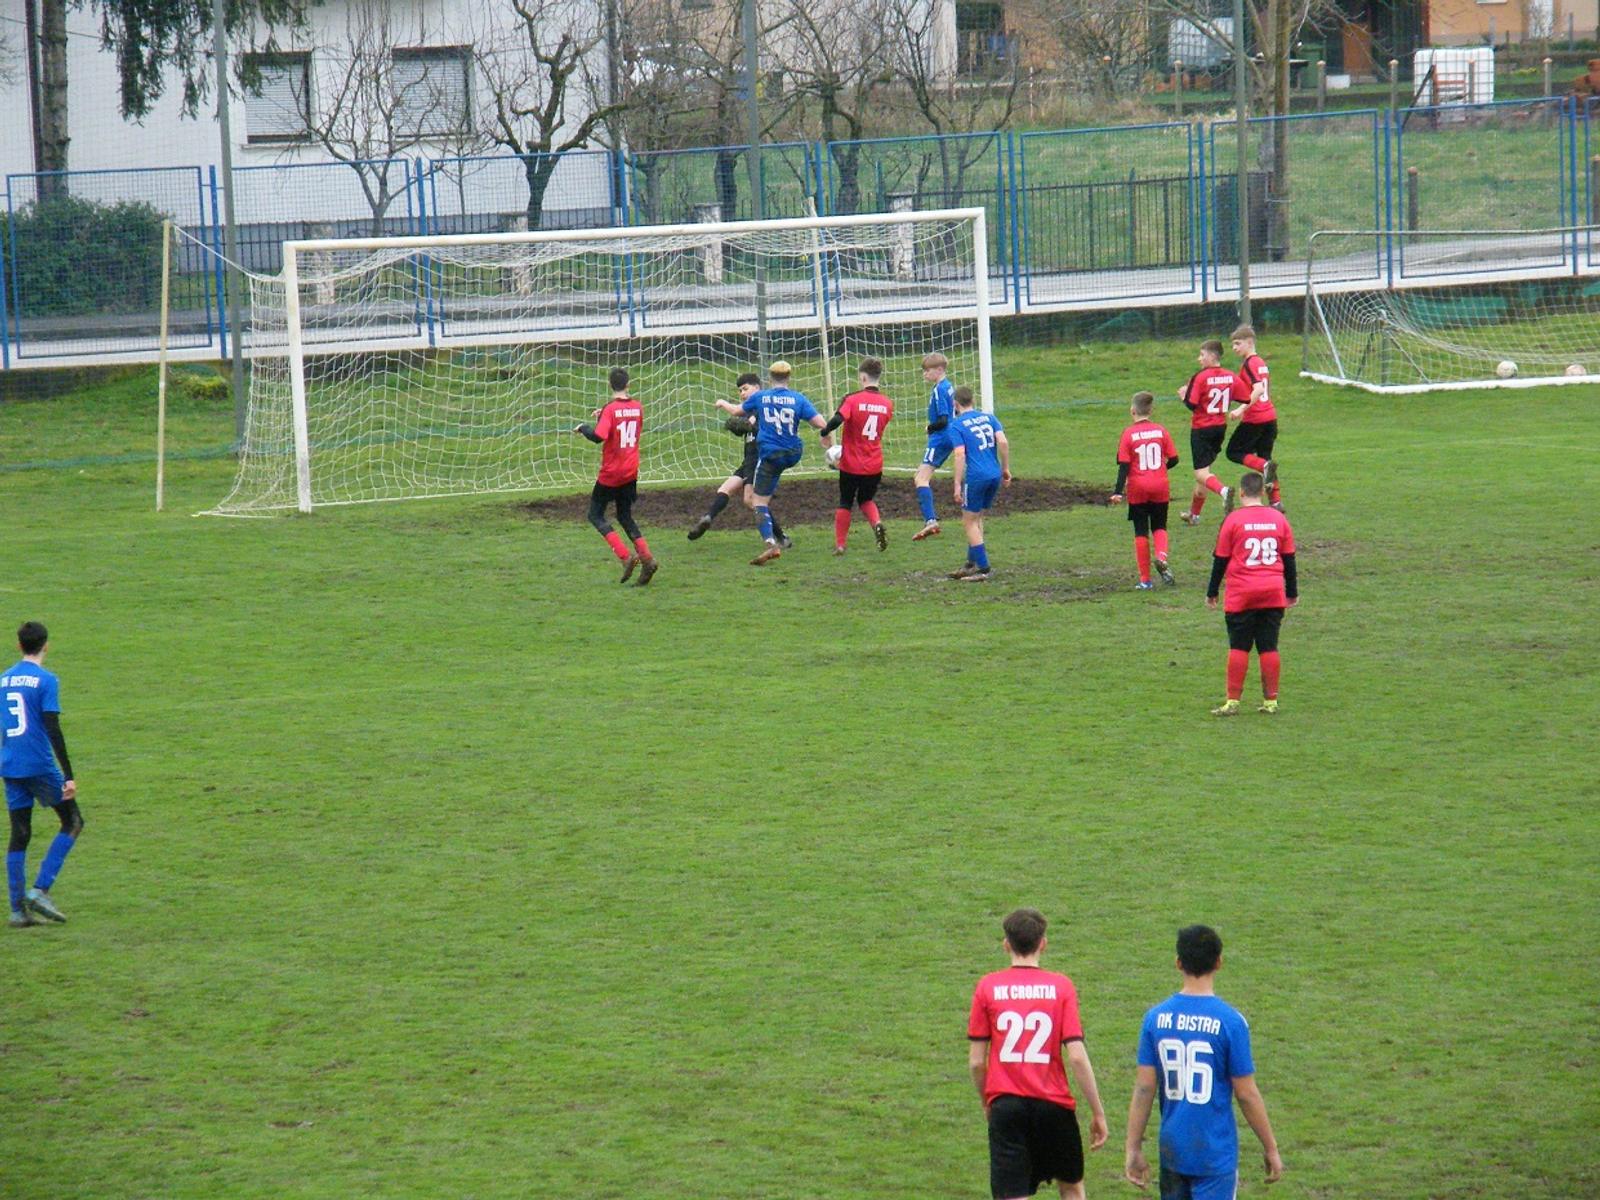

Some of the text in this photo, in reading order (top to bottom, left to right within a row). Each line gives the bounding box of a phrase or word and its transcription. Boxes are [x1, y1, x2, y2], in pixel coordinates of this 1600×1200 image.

[1207, 387, 1230, 414] 21
[616, 420, 637, 449] 14
[763, 407, 795, 436] 49
[862, 414, 878, 441] 4
[970, 423, 995, 450] 33
[1134, 442, 1162, 471] 10
[1244, 537, 1278, 566] 28
[6, 692, 27, 738] 3
[993, 985, 1056, 1000] NK CROATIA
[996, 1011, 1053, 1064] 22
[1157, 1012, 1221, 1035] NK BISTRA
[1158, 1038, 1214, 1104] 86
